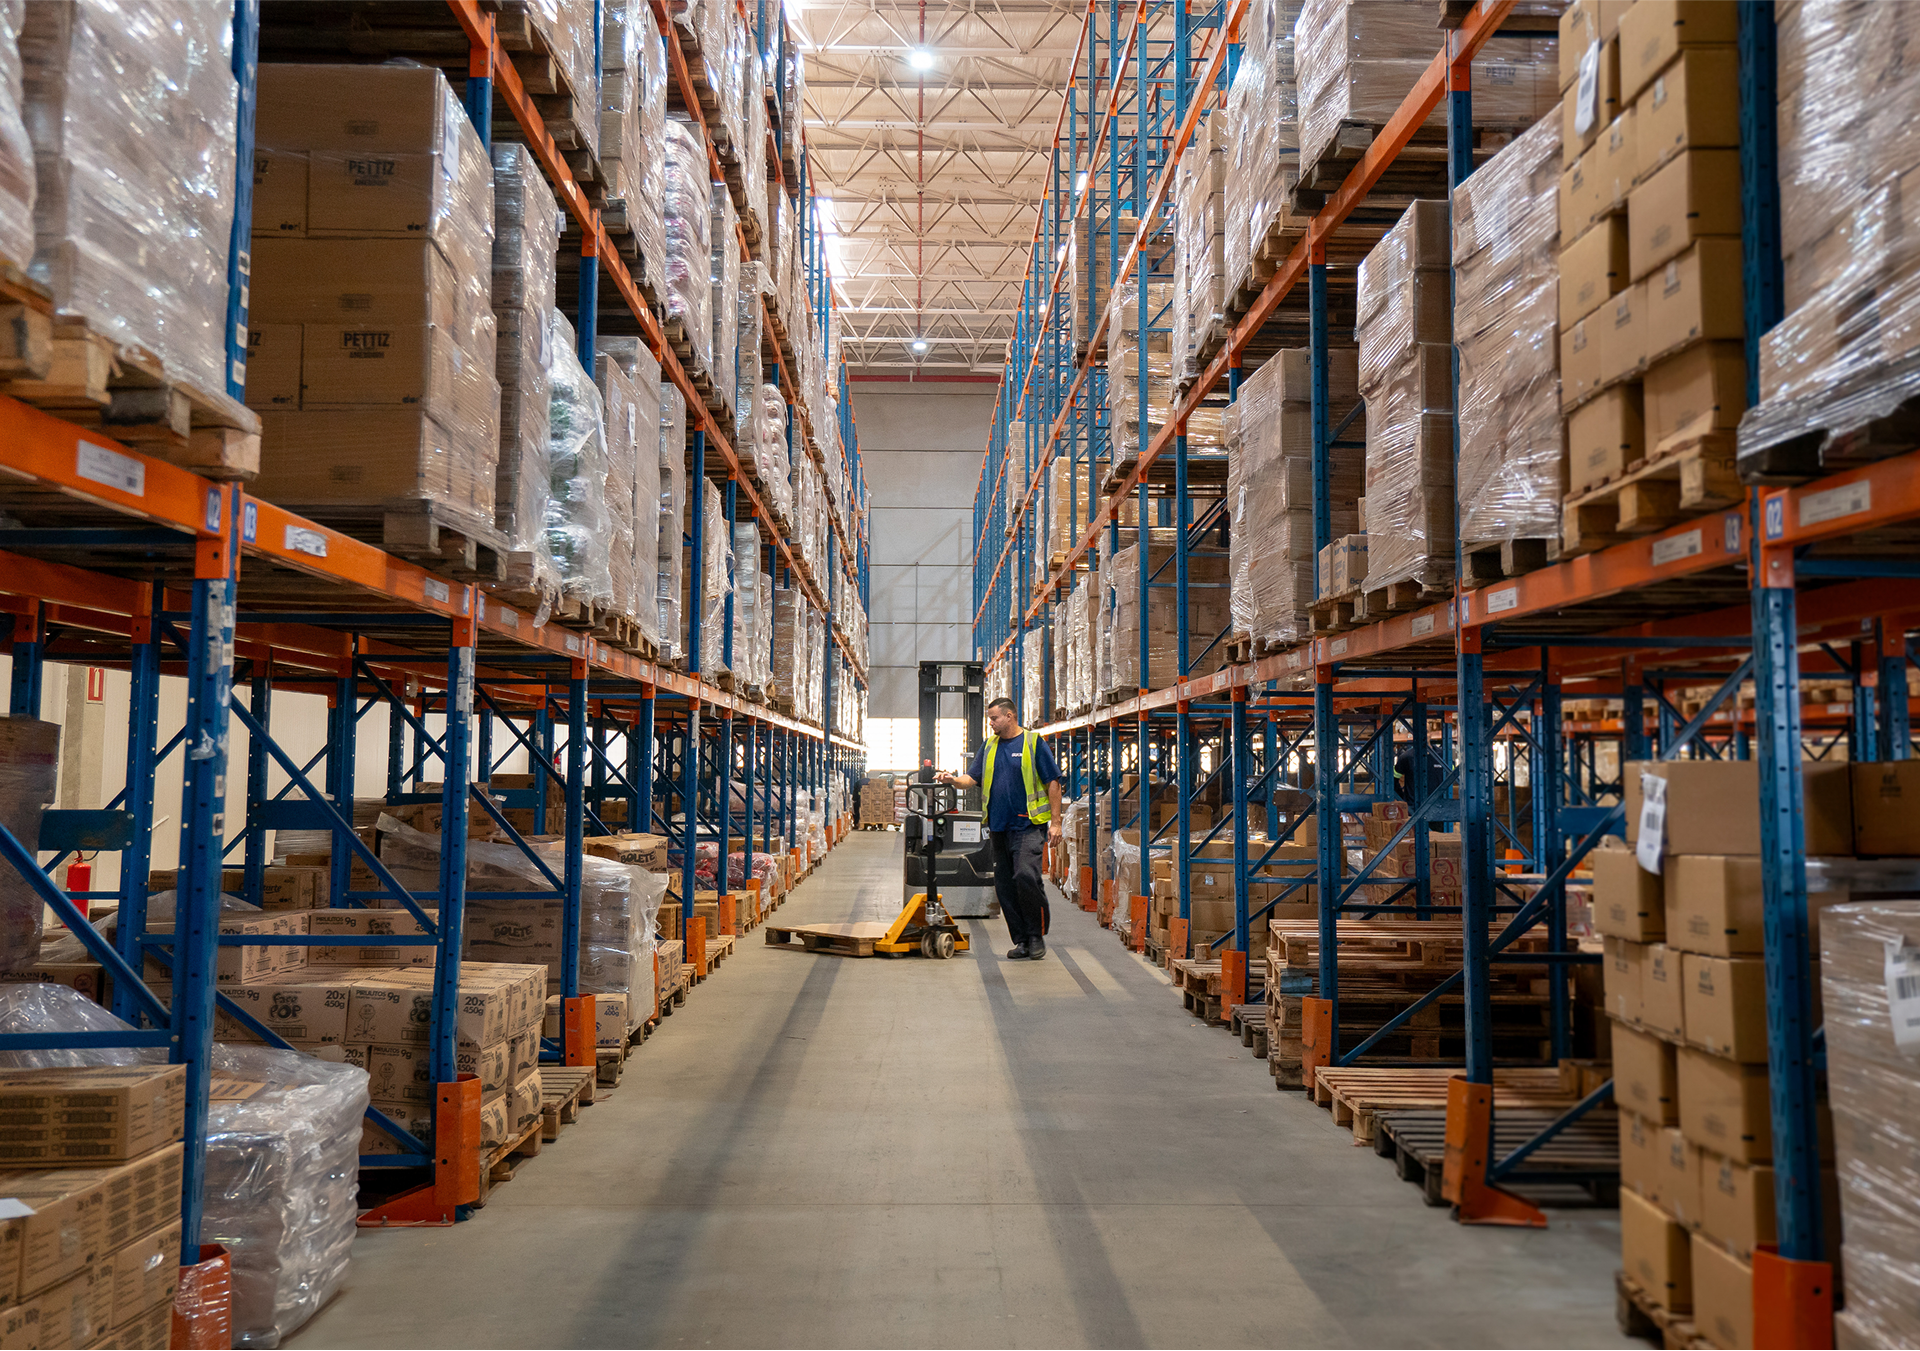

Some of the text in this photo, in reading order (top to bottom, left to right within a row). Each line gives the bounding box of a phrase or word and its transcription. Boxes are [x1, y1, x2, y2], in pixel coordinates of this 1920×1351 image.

[1485, 67, 1517, 78] PETTIZ
[349, 160, 395, 176] PETTIZ
[344, 332, 390, 348] PETTIZ
[206, 492, 220, 529] 02
[244, 504, 257, 539] 03
[1766, 501, 1782, 535] 02
[1725, 518, 1740, 550] 03
[620, 850, 657, 864] BOLETE
[344, 916, 356, 927] 9g
[493, 924, 533, 938] BOLETE
[412, 954, 429, 964] dori
[219, 969, 237, 981] dori
[246, 990, 260, 1001] 9g
[325, 990, 346, 1000] 20x
[355, 989, 400, 1004] PIRULITOS 9g
[464, 996, 486, 1006] 20x
[324, 1000, 345, 1010] 450g
[463, 1006, 484, 1016] 450g
[270, 1004, 302, 1019] POP
[321, 1032, 340, 1043] dori
[459, 1038, 478, 1049] dori
[344, 1049, 365, 1058] 20x
[373, 1046, 412, 1060] PIRULITOS 9g
[457, 1053, 477, 1065] 20x
[394, 1108, 406, 1119] 9g
